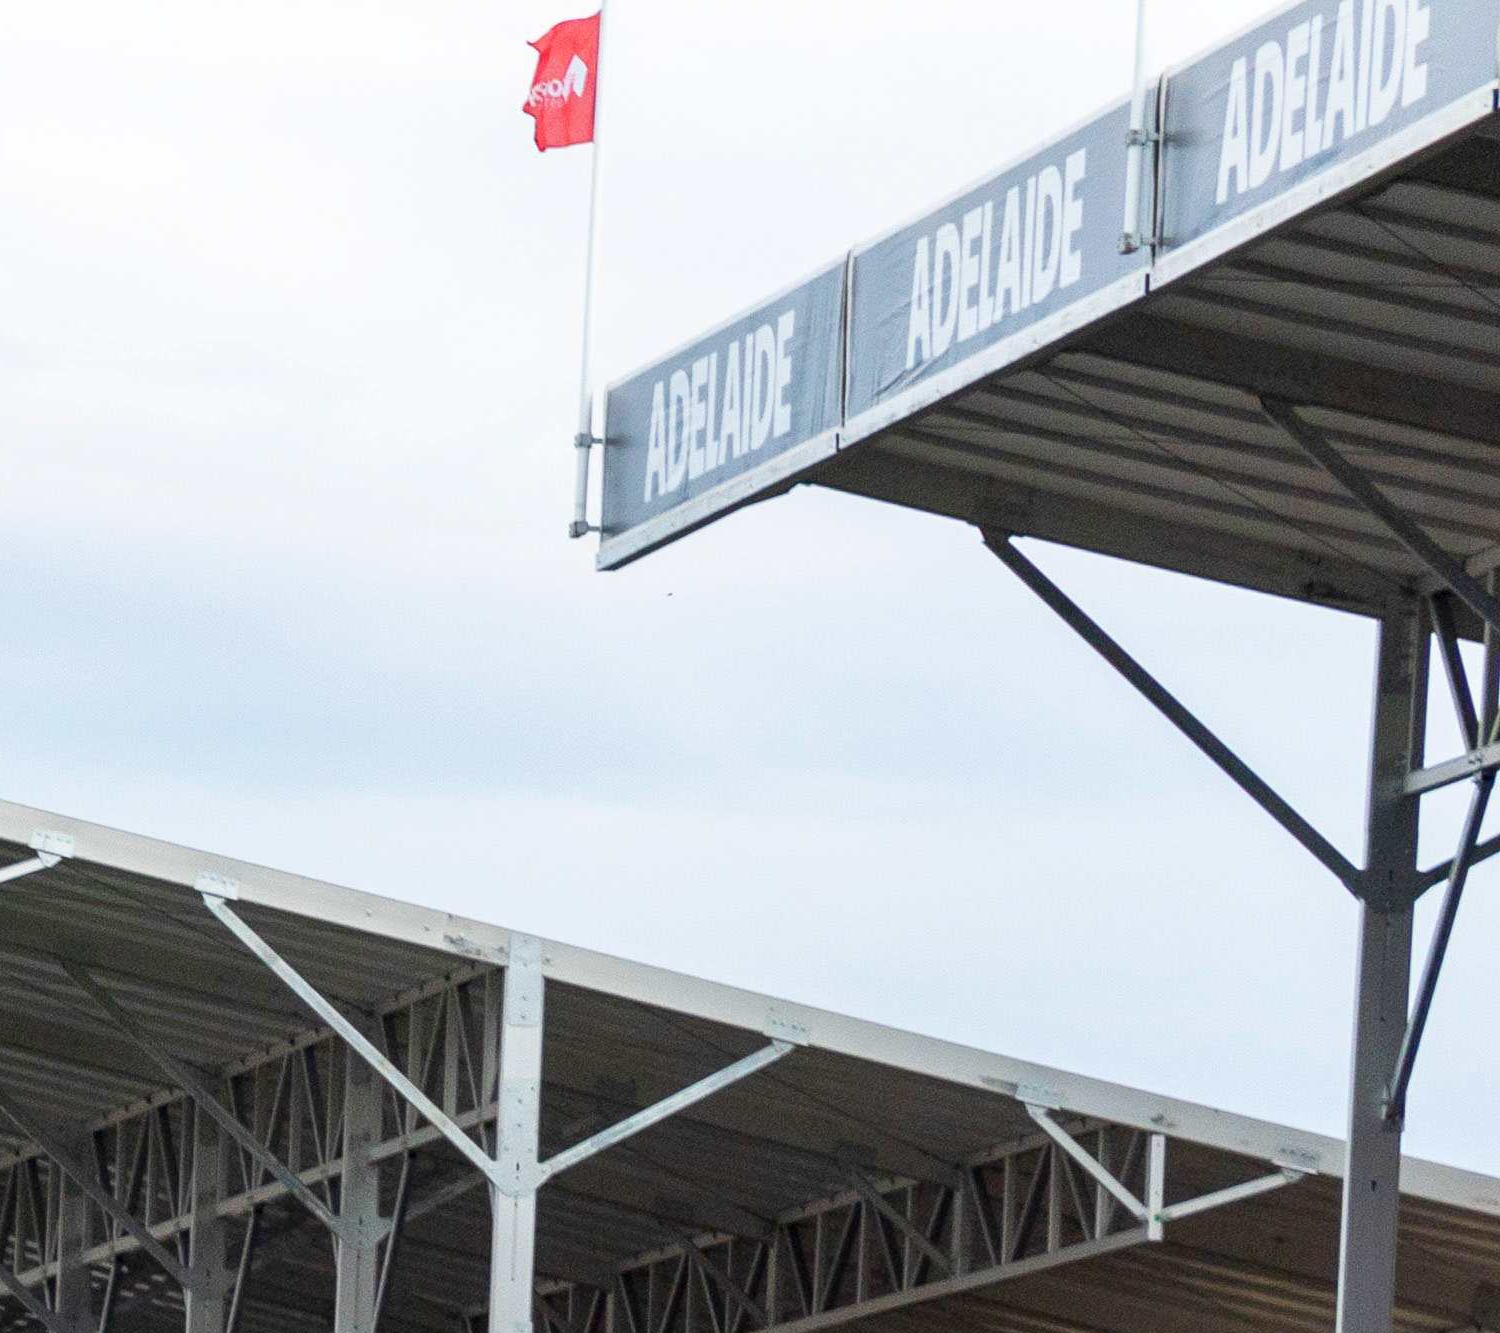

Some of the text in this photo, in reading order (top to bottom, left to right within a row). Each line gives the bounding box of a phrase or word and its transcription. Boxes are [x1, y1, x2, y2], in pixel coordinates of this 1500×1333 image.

[1216, 0, 1430, 205] ADELAIDE
[906, 148, 1087, 370] ADELAIDE
[643, 309, 796, 502] ADELAIDE
